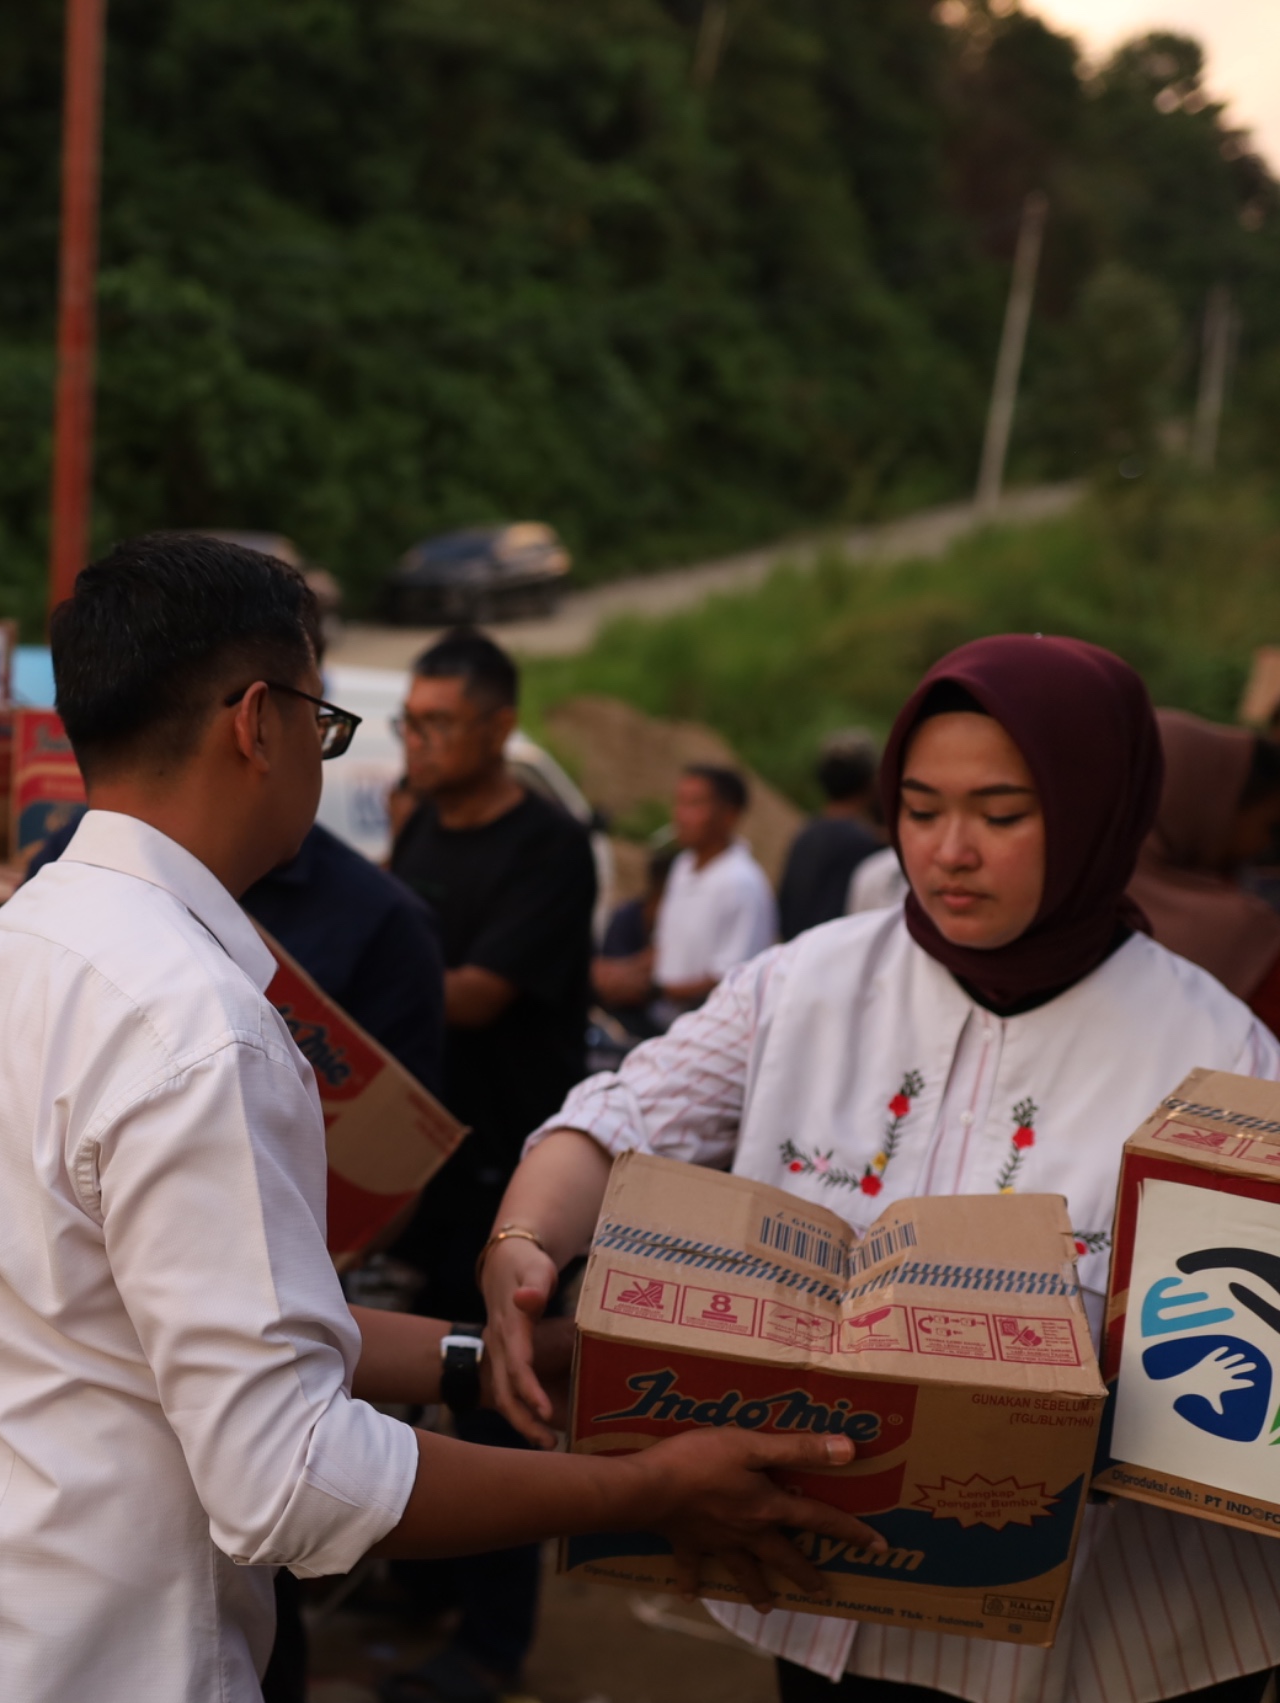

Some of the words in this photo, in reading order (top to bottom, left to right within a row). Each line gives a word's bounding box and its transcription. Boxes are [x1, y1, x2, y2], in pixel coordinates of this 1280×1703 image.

[710, 1294, 732, 1313] 8
[972, 1393, 1031, 1408] GUNAKAN
[1034, 1398, 1090, 1412] SEBELUM
[1009, 1412, 1095, 1428] (TGL/BLN/THN)
[958, 1489, 1015, 1500] Lengkap
[1111, 1469, 1168, 1493] Diproduksi
[1170, 1486, 1192, 1501] oleh
[1204, 1494, 1223, 1508] PT
[937, 1499, 986, 1510] Dengan
[991, 1499, 1038, 1508] Bumbu
[975, 1509, 1001, 1518] Kari
